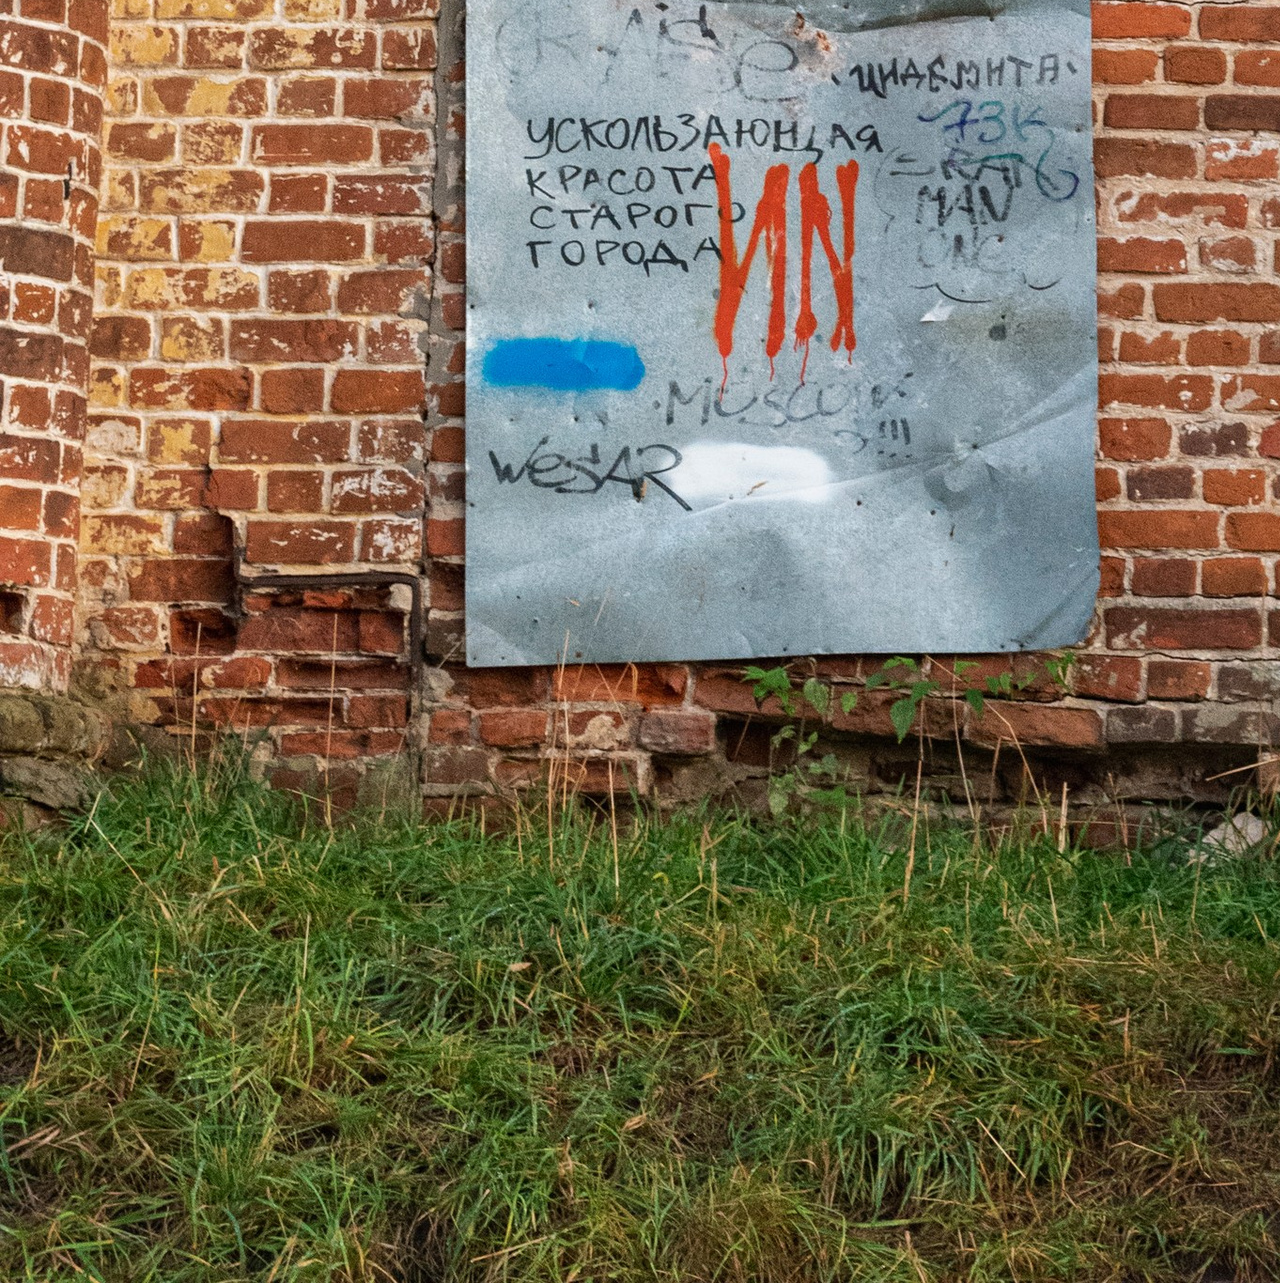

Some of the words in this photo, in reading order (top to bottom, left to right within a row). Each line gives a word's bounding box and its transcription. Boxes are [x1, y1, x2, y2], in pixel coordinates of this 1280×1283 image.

[525, 113, 884, 164] УСКОЛЬЗАЮЩАЯ
[525, 163, 717, 199] КРАСОТА
[529, 201, 746, 230] СТАРОГО
[525, 236, 726, 277] ГОРОДА
